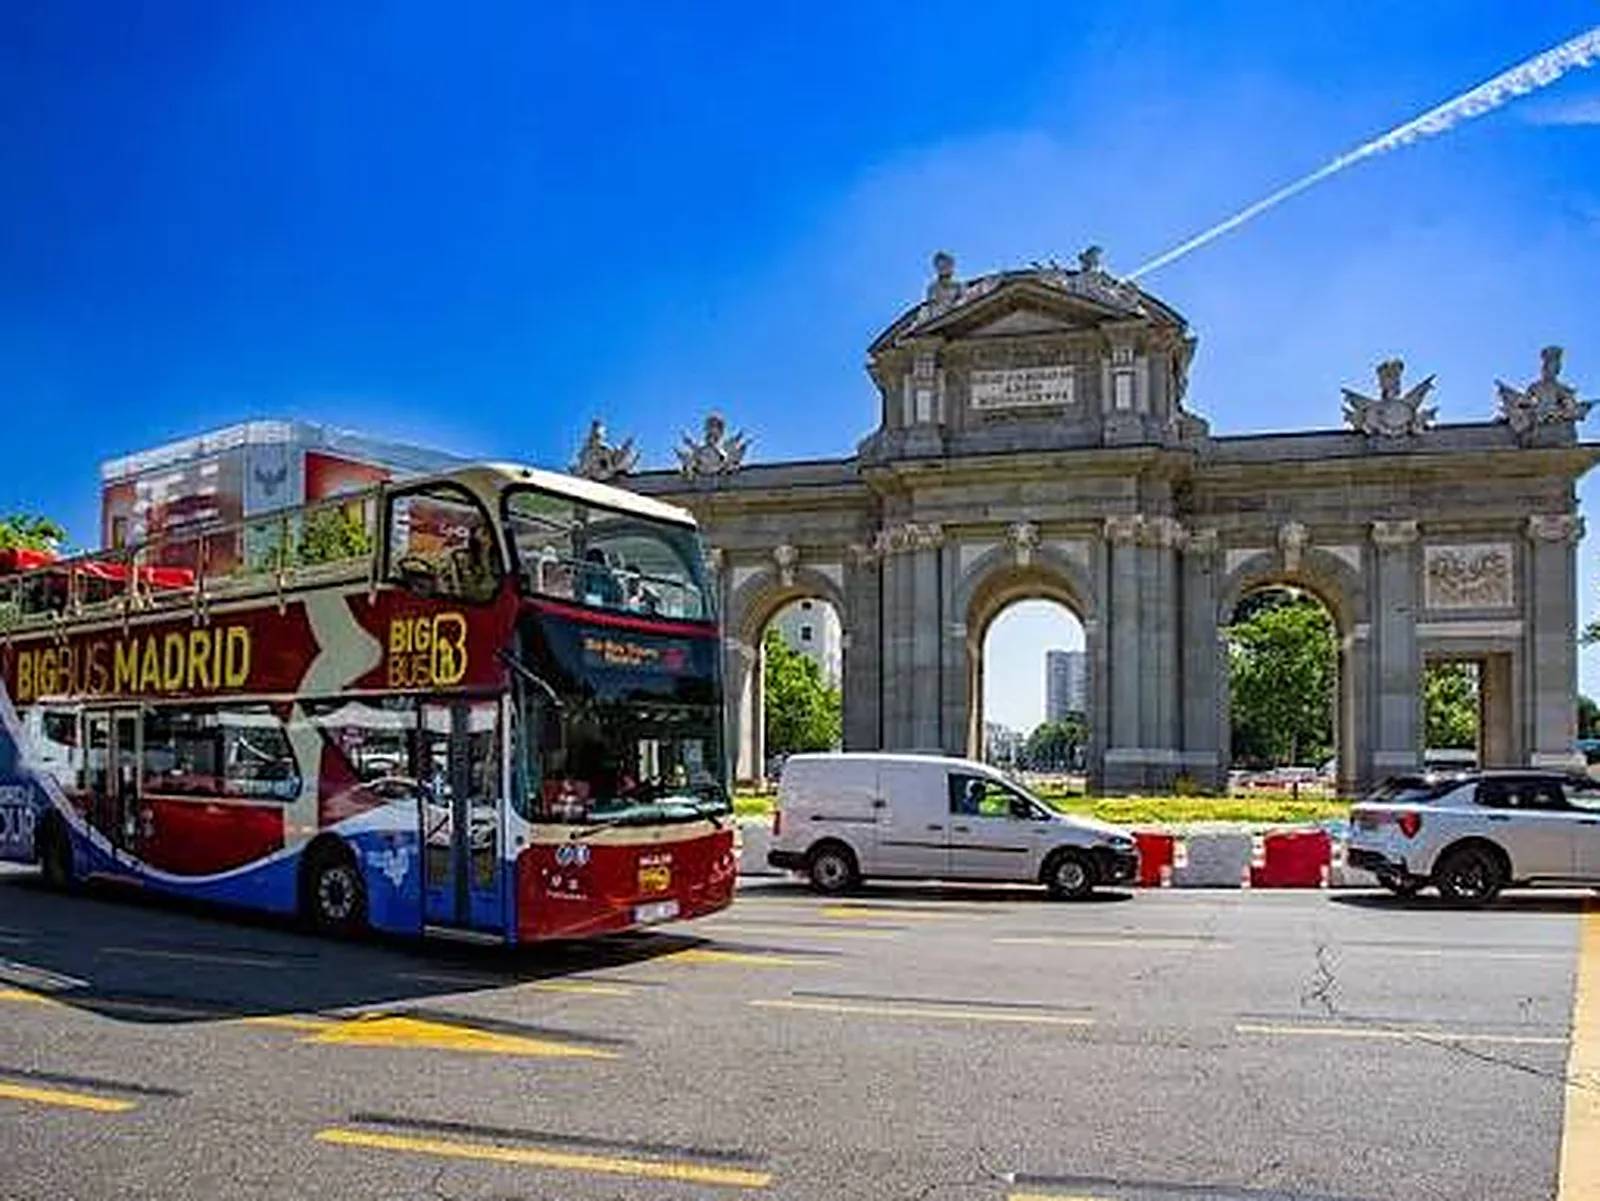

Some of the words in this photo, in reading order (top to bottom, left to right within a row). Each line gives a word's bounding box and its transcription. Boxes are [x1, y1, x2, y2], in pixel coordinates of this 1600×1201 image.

[389, 618, 431, 652] BIG
[113, 626, 250, 692] MADRID
[388, 655, 432, 687] BUS
